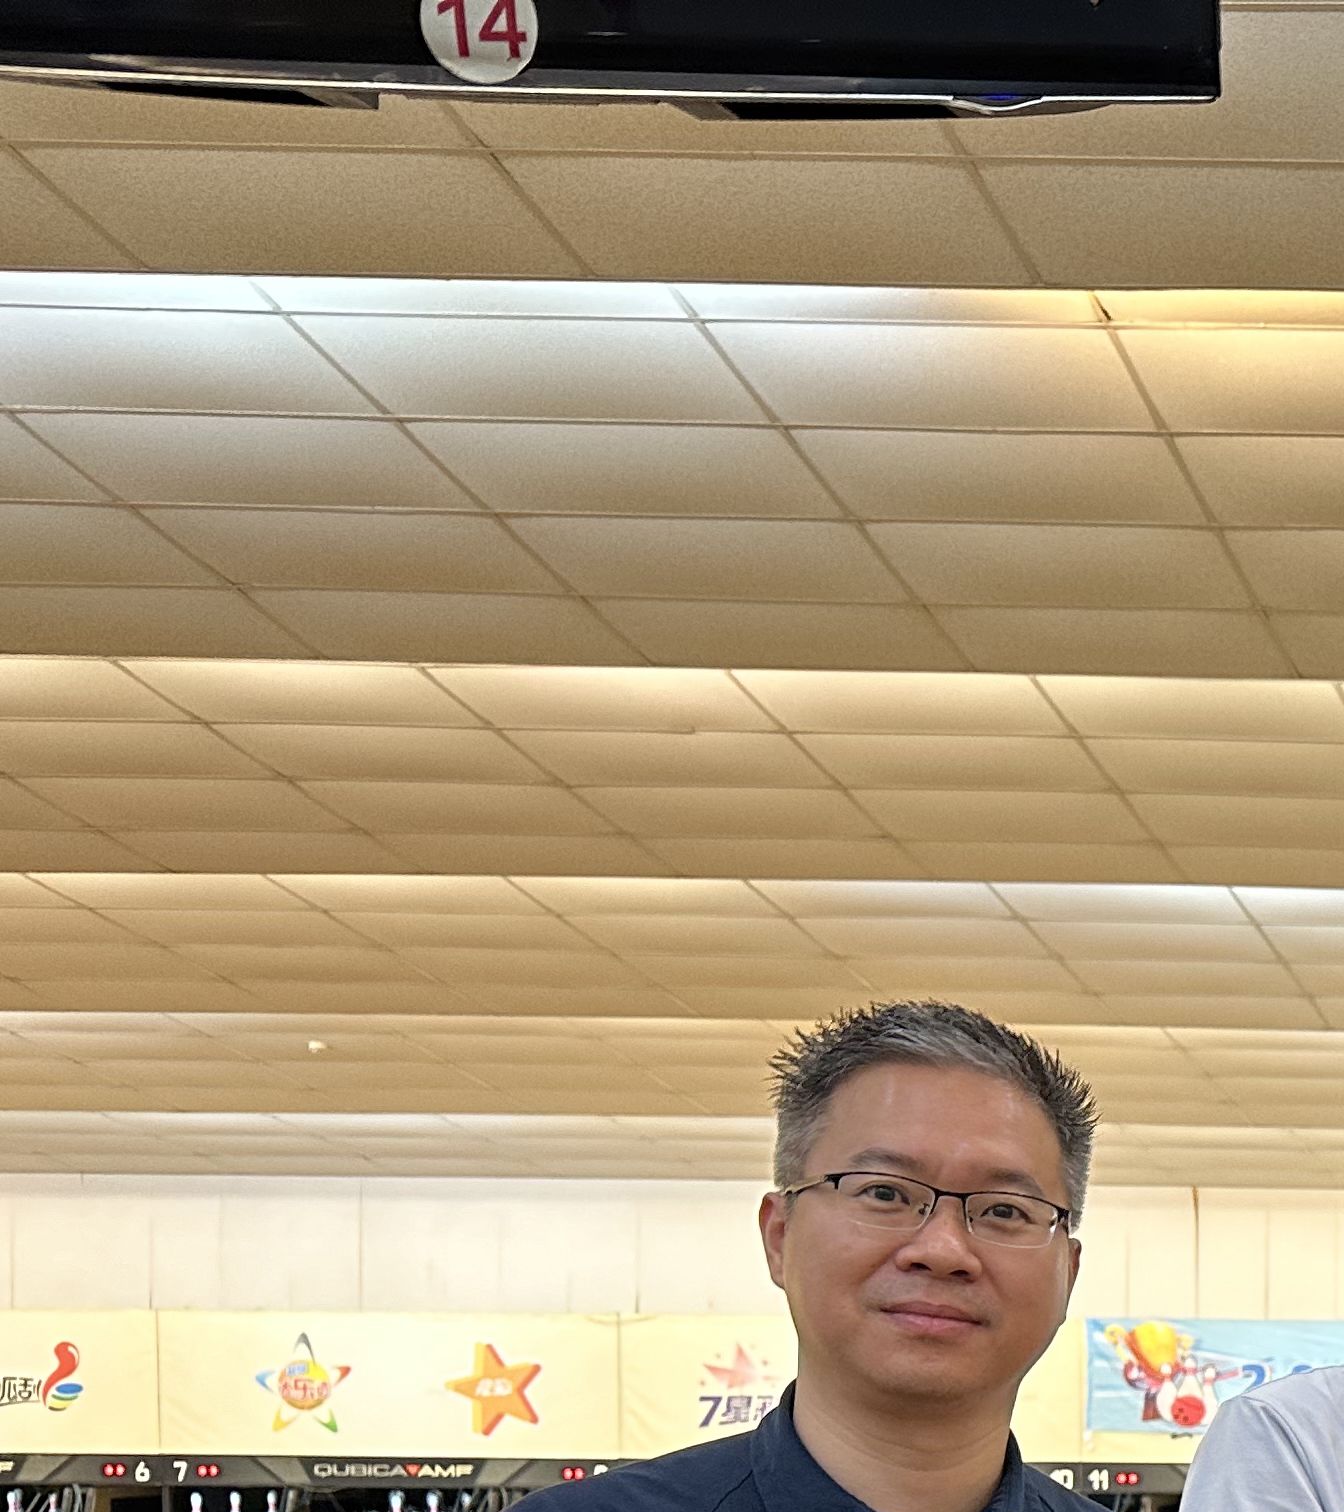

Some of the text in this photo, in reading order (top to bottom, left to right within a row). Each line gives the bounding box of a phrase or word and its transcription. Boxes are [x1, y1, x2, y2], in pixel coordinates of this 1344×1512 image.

[437, 0, 527, 58] 14
[135, 1461, 150, 1482] 6
[173, 1460, 187, 1482] 7
[1087, 1469, 1109, 1491] 11
